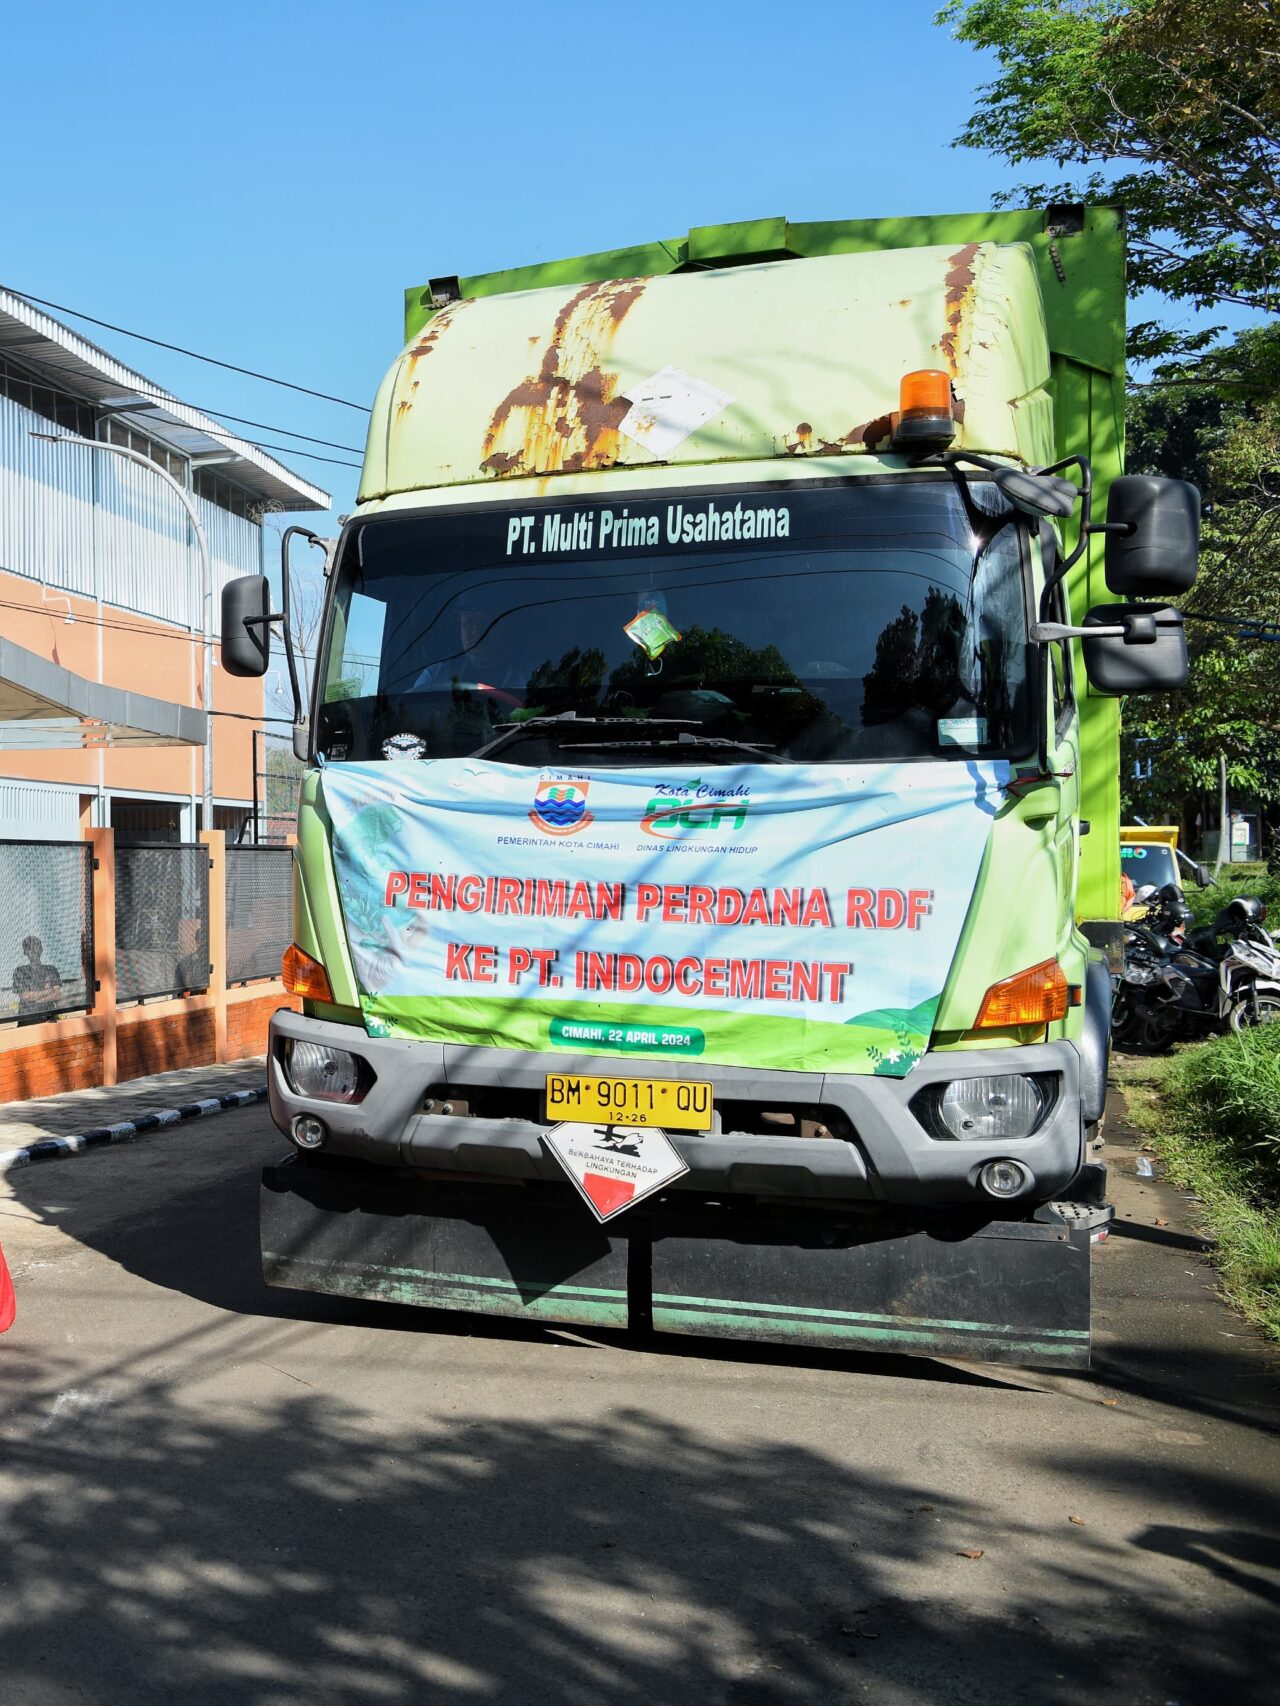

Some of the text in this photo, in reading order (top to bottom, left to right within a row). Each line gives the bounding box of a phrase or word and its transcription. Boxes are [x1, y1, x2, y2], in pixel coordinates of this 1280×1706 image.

[506, 502, 790, 555] PT. Multi Prima Usahatama
[654, 783, 751, 799] Kota Cimahi
[497, 836, 620, 851] PEMERINTAH KOTA CIMAHI
[636, 844, 758, 854] DINAS LINGKUNGAN HIDUP
[384, 870, 931, 930] PENGIRIMAN PERDANA RDF
[444, 943, 850, 1004] KE PT. INDOCEMENT
[561, 1025, 691, 1046] CIMAHI, 22 APRIL 2024
[550, 1078, 707, 1113] BM 9011 QU
[568, 1148, 659, 1175] BERBAHAYA TERHADAP
[585, 1161, 638, 1179] LINGKUNGAN
